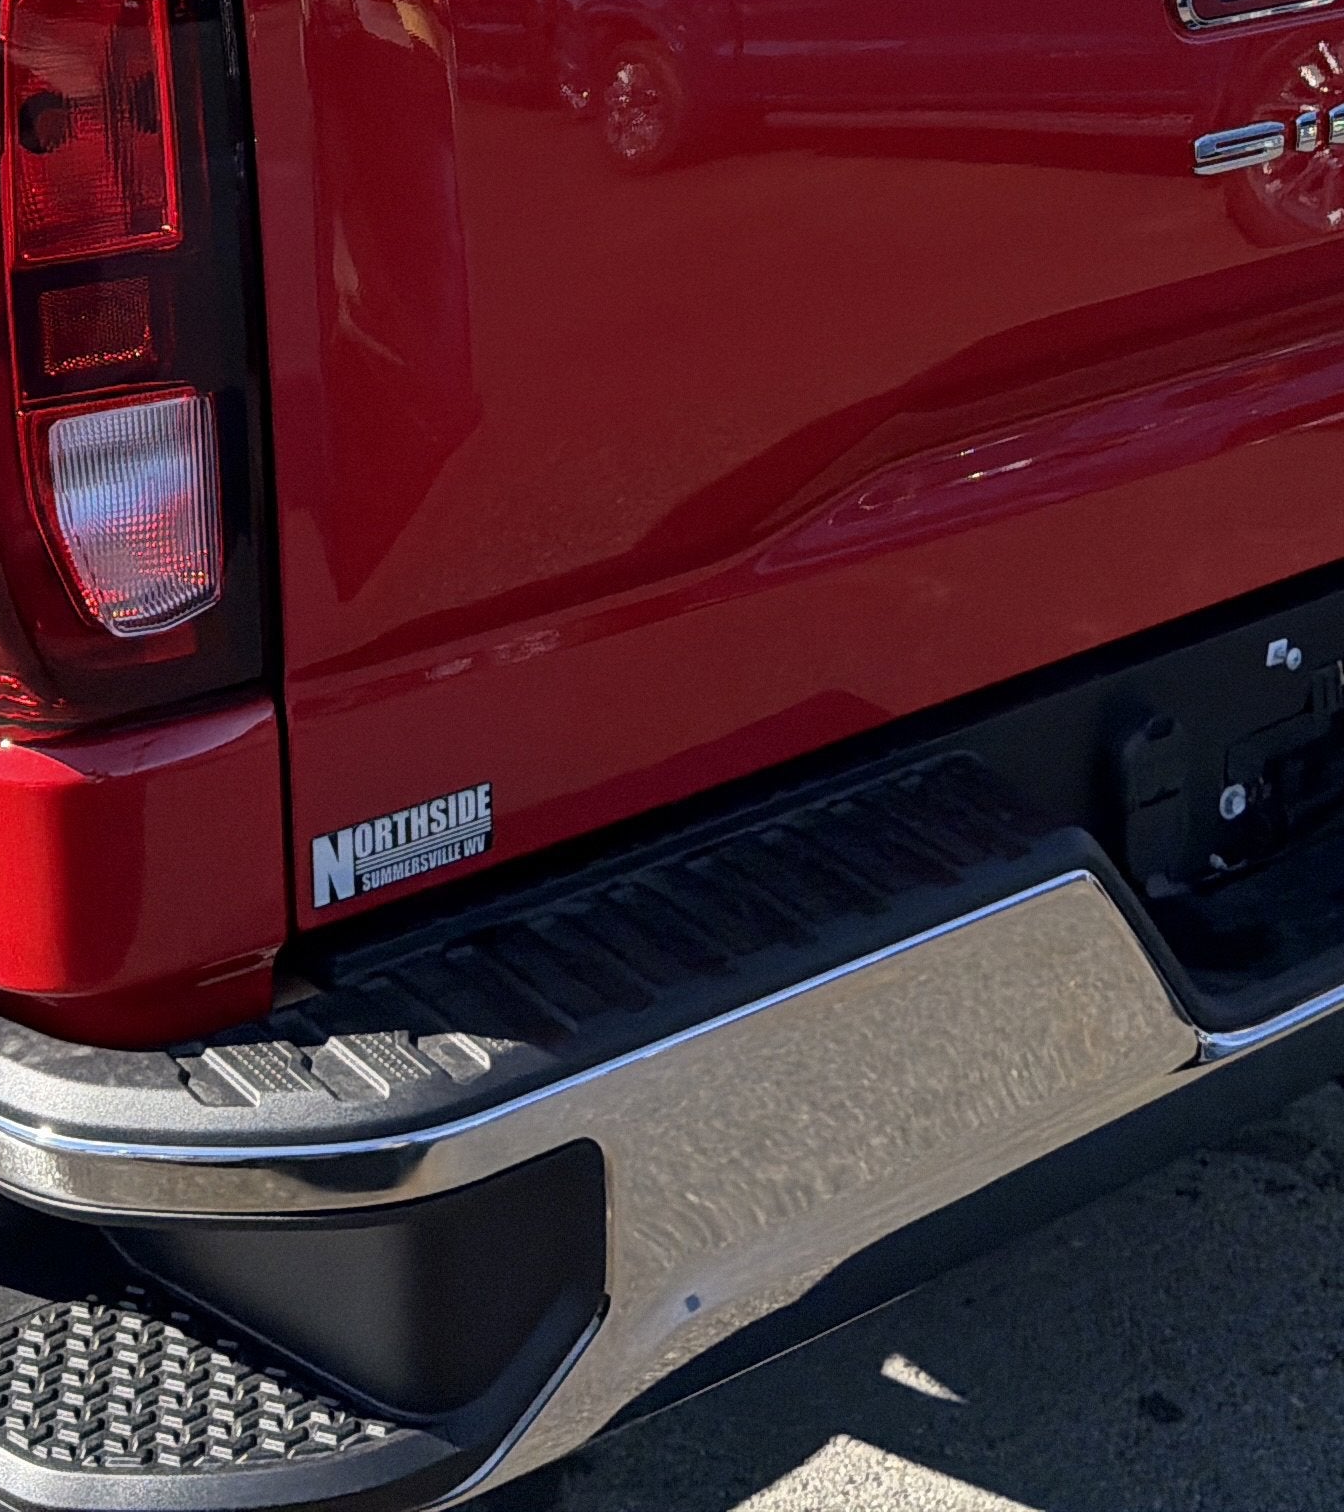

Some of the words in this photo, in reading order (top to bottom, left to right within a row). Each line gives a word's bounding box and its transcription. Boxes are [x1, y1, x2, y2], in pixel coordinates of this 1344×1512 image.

[312, 782, 492, 908] NORTHSIDE
[361, 843, 462, 892] SUMMERSVILLE
[463, 834, 486, 857] WV
